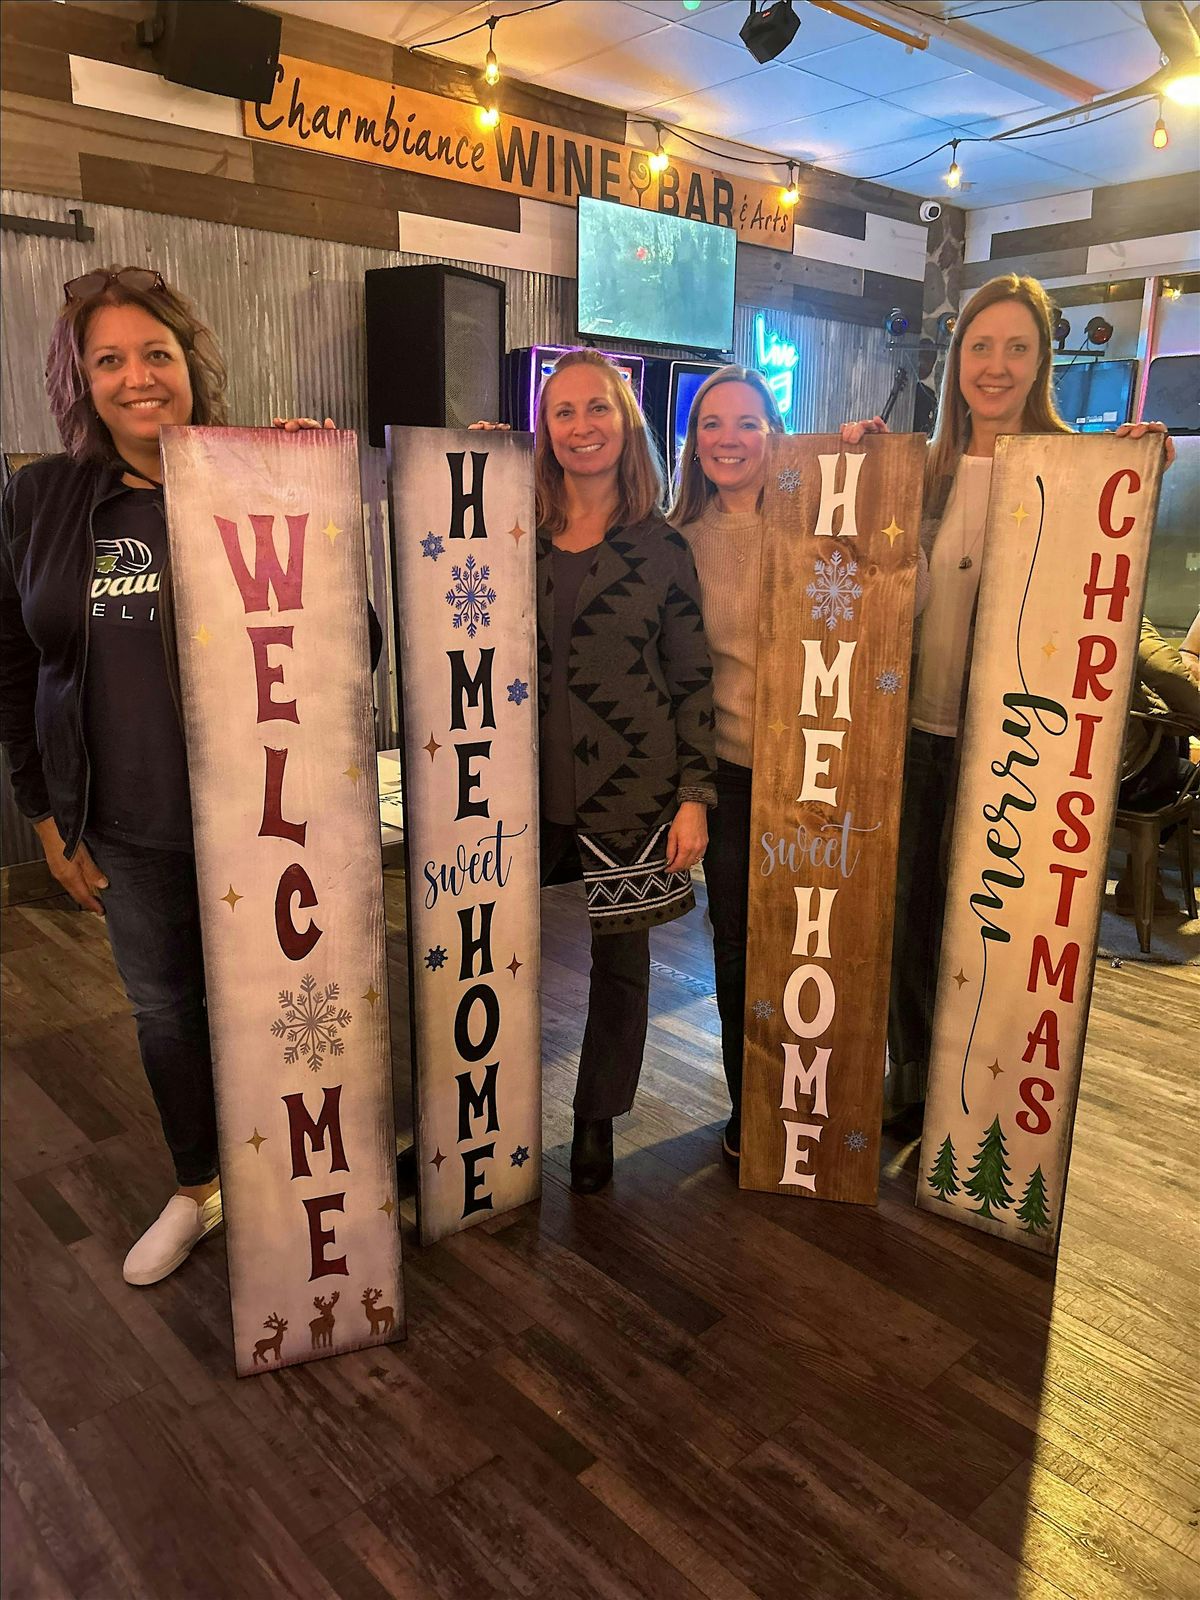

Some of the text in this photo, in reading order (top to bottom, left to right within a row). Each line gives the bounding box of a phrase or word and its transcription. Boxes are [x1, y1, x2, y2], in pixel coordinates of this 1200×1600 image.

[255, 63, 486, 172] Charmbiance
[494, 124, 621, 205] WINE
[657, 163, 734, 229] BAR
[749, 198, 790, 234] Arts
[423, 820, 528, 909] sweet
[760, 811, 882, 878] sweet
[1015, 468, 1141, 1135] CHRISTMAS
[454, 900, 501, 1219] HOME
[778, 886, 837, 1192] HOME
